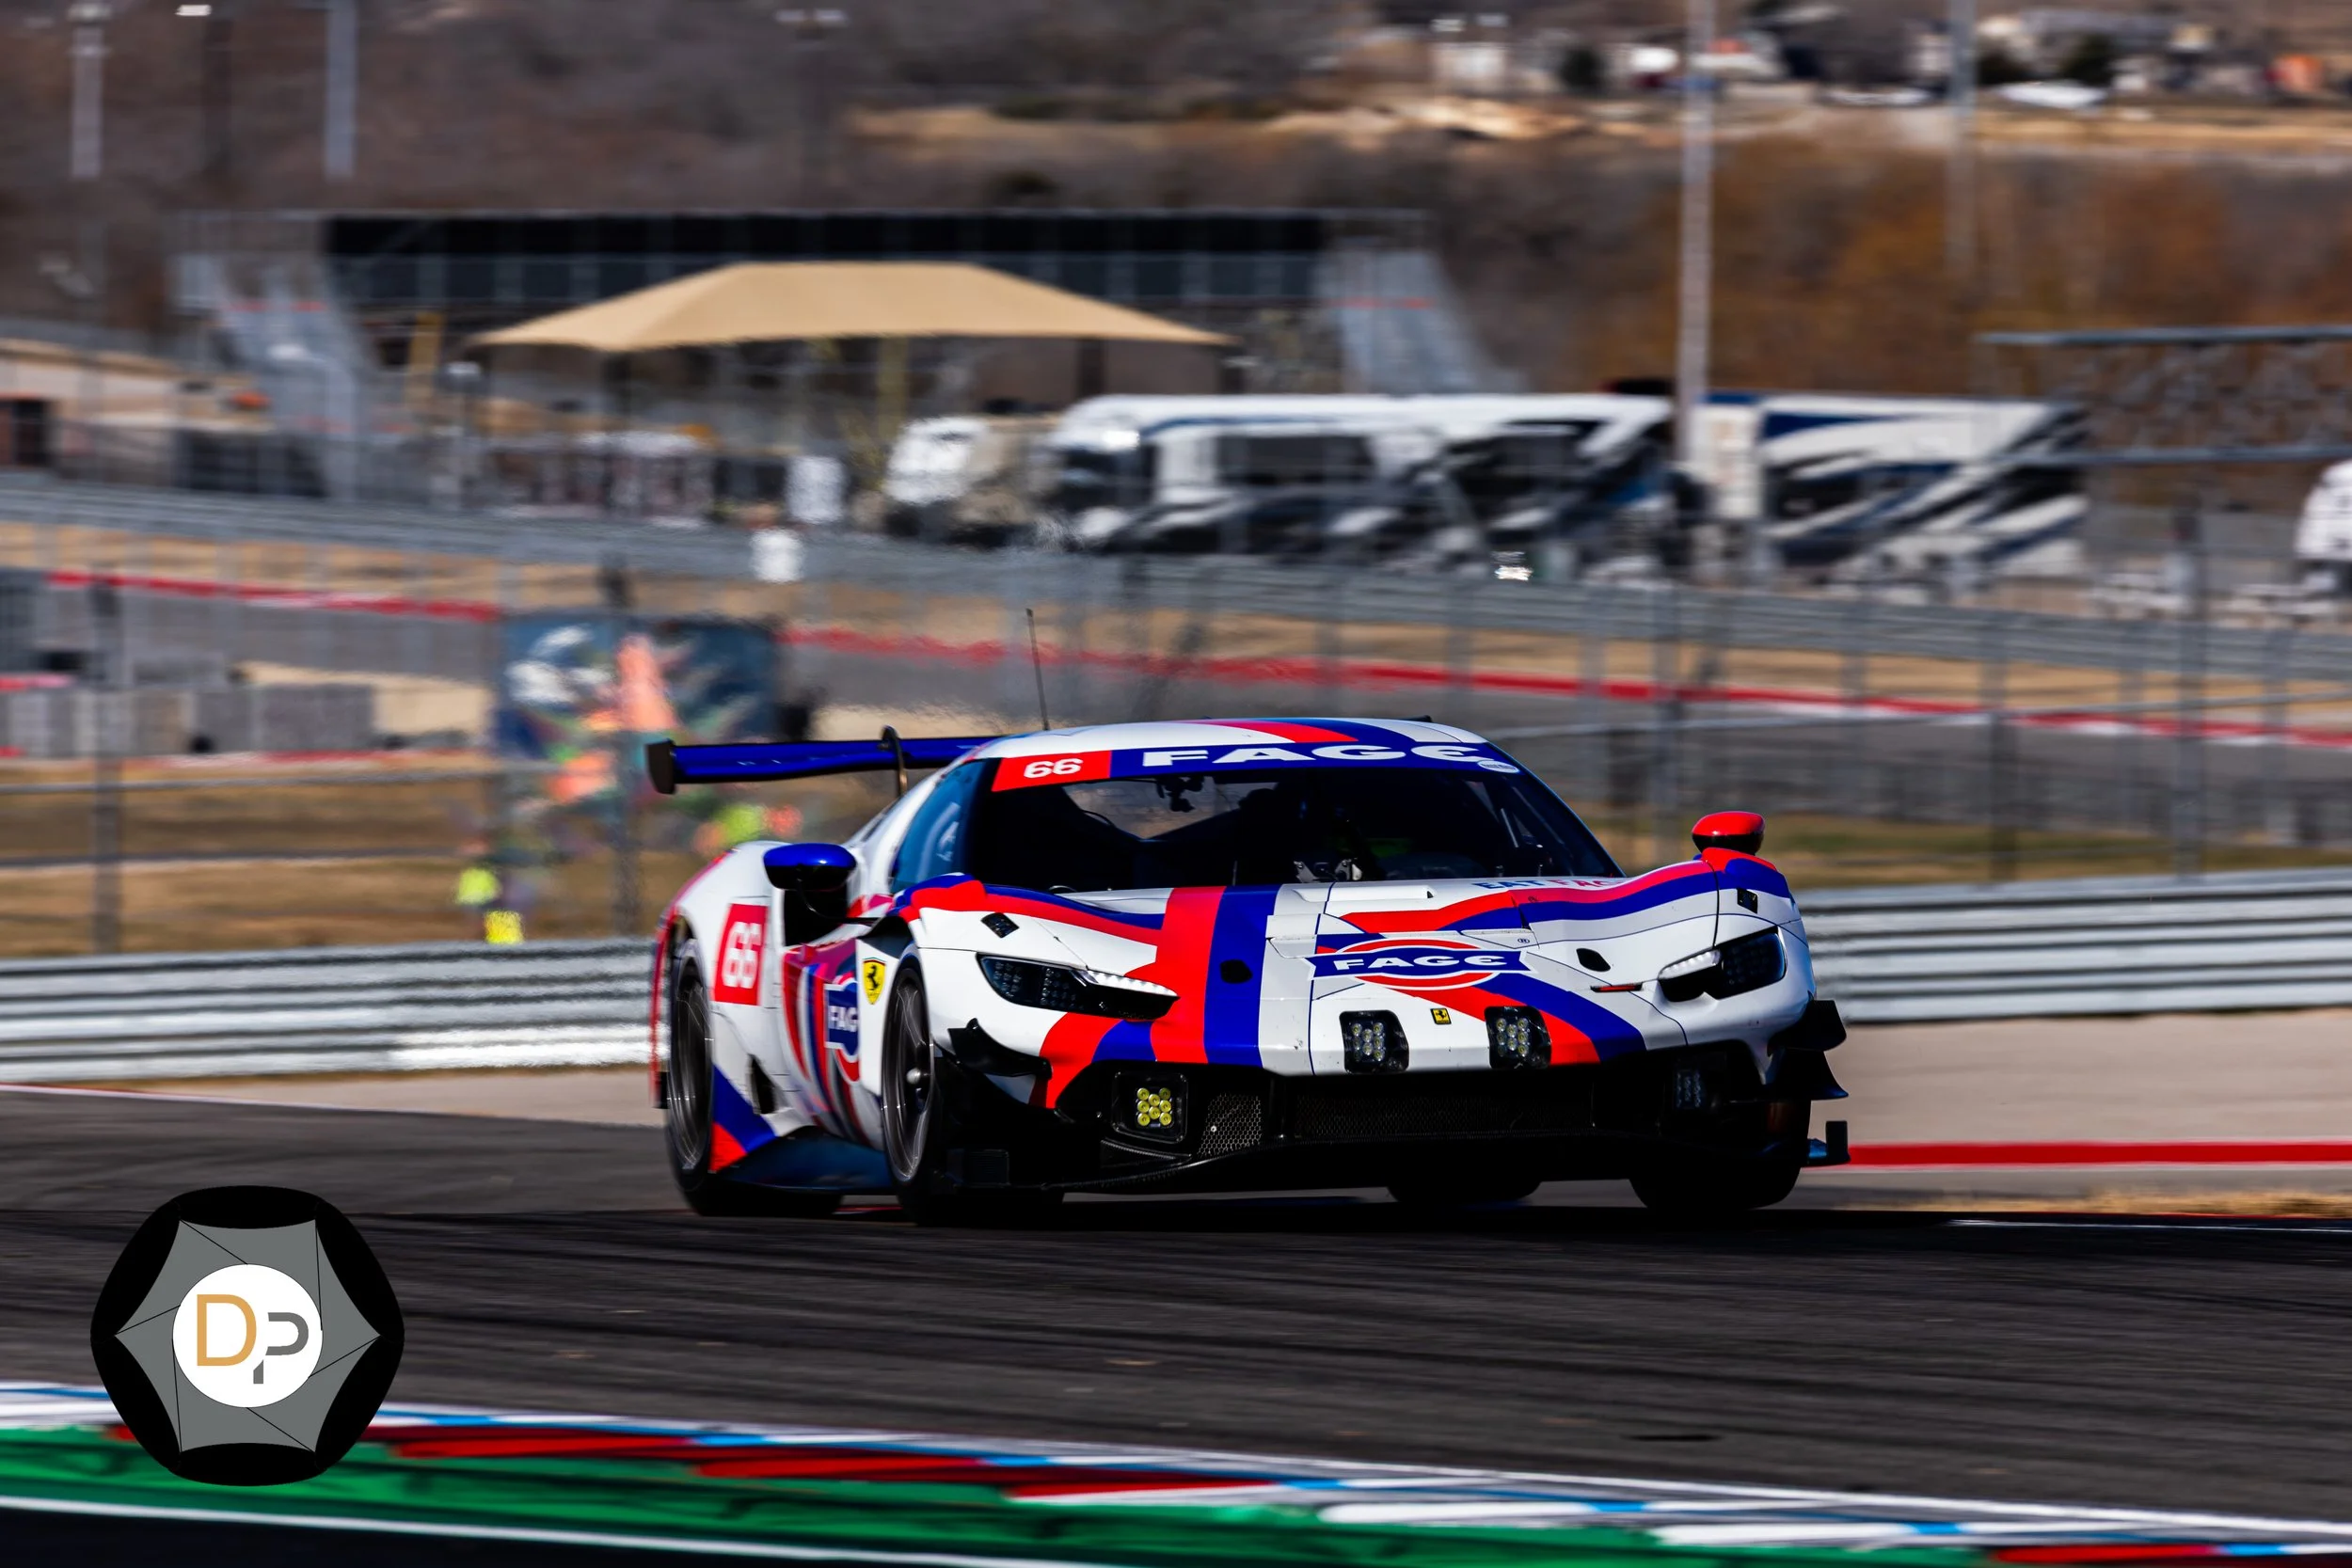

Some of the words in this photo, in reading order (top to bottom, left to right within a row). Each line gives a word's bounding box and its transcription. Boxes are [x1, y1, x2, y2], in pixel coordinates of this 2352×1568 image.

[1142, 744, 1495, 768] FAGE
[1024, 758, 1083, 778] 66
[1472, 880, 1545, 889] EAT
[722, 921, 763, 990] 66
[1333, 955, 1508, 971] FAGE
[827, 1005, 858, 1033] FAG
